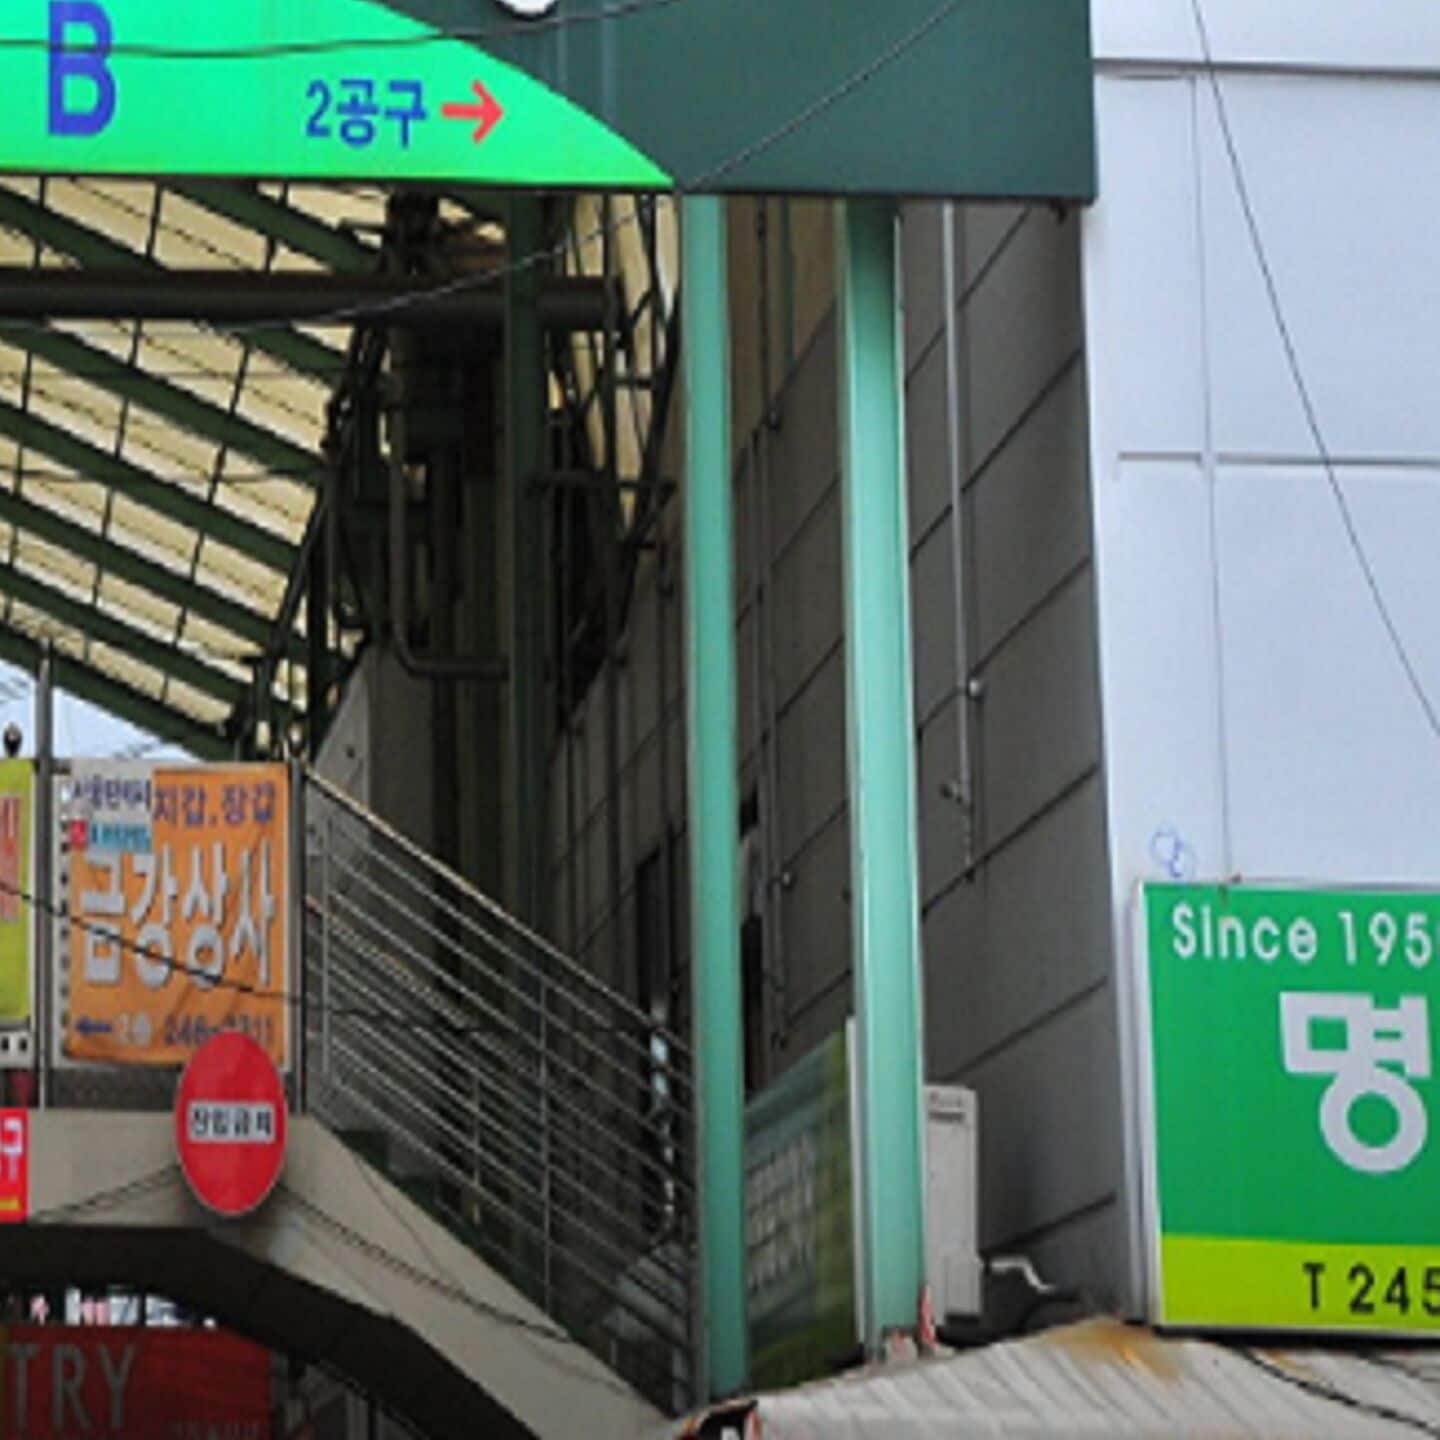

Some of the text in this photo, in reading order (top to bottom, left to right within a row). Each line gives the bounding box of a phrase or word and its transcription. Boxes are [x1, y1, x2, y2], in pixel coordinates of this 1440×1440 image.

[48, 0, 116, 137] B
[305, 79, 427, 148] 2공구
[79, 838, 276, 988] 금강상사
[1337, 910, 1440, 969] 195
[1279, 991, 1433, 1174] 명
[7, 1341, 139, 1431] TRY
